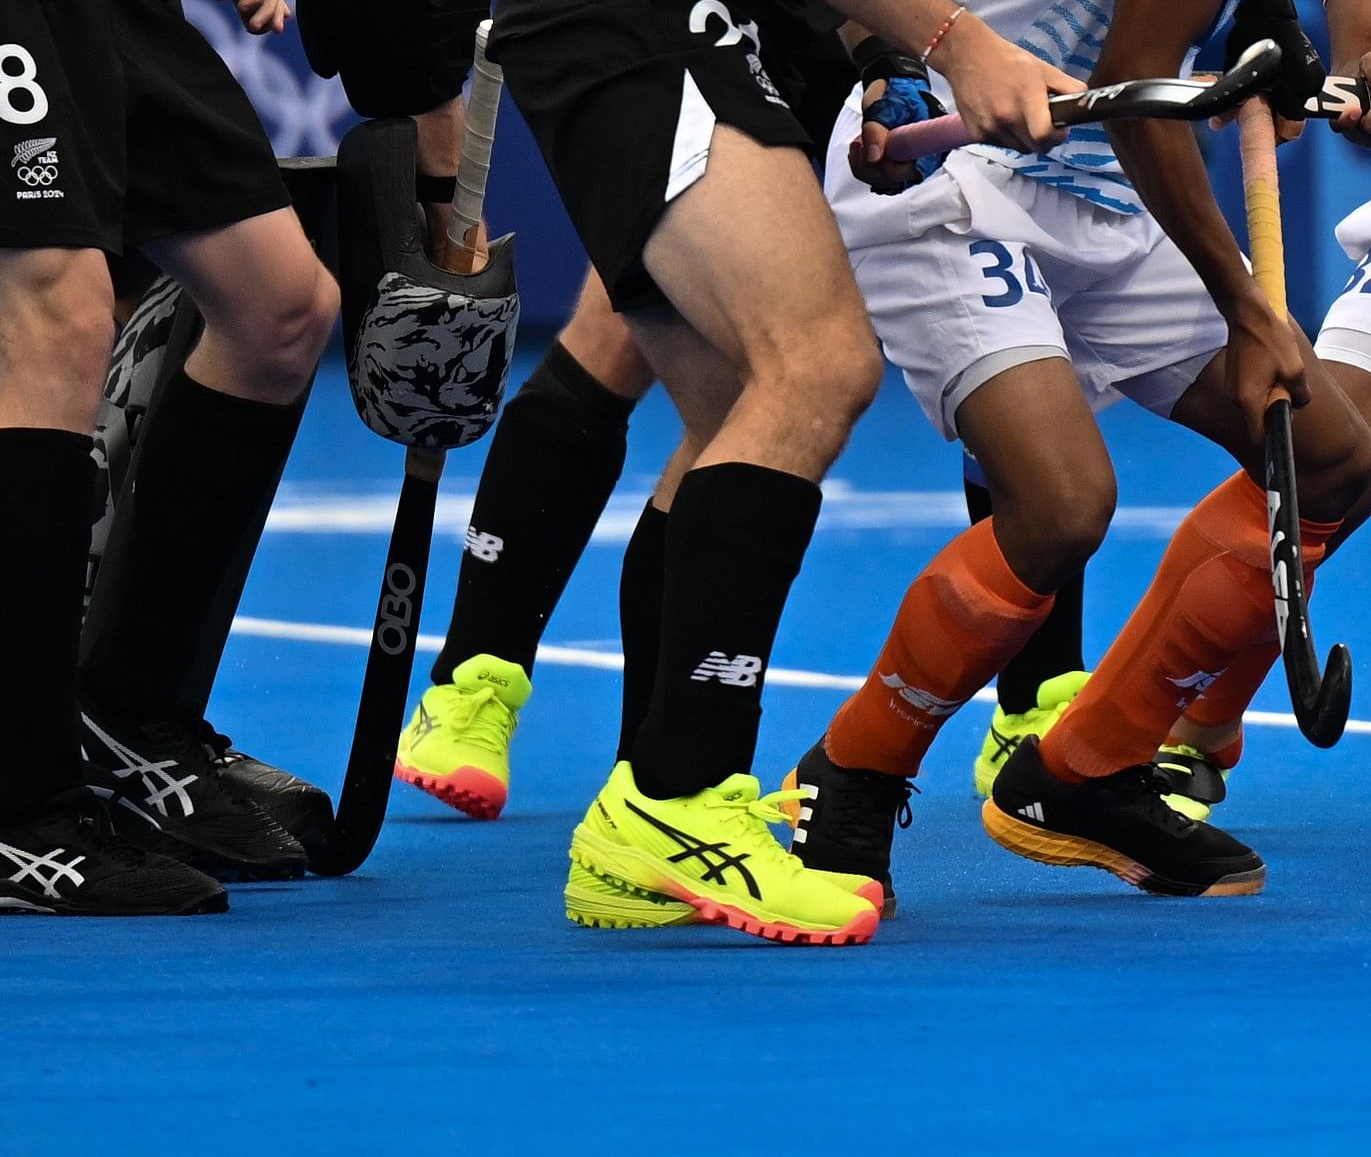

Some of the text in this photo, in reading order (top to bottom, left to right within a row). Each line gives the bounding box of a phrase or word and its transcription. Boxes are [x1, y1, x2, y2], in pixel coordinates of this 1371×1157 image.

[37, 156, 58, 164] TEAM
[43, 189, 64, 198] 2024
[377, 562, 416, 655] OBO
